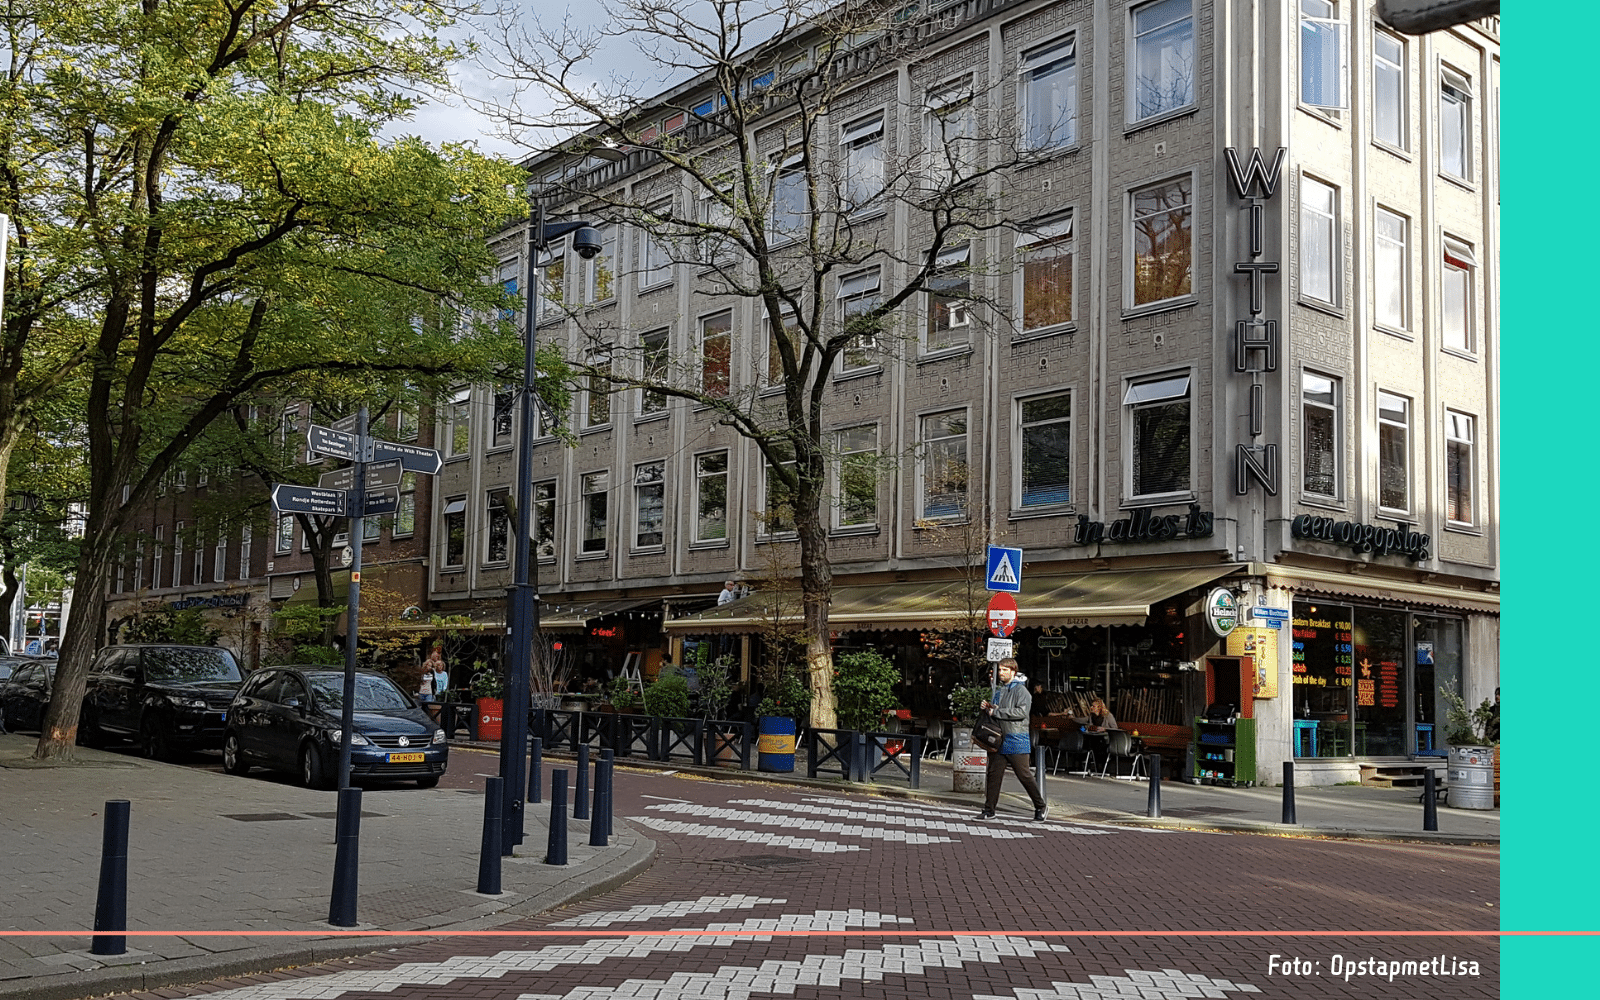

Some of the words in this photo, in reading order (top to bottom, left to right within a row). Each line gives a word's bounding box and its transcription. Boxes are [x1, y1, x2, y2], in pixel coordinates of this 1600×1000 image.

[1224, 147, 1287, 495] WITHIN
[311, 490, 336, 498] Westblaak
[1074, 514, 1104, 544] in
[1109, 508, 1179, 543] alles
[1184, 503, 1213, 538] is
[1291, 514, 1334, 540] een
[1334, 521, 1430, 561] oogopslag
[1309, 618, 1331, 628] Breakfast
[1303, 675, 1309, 684] of
[1309, 675, 1317, 685] the
[1318, 676, 1327, 687] day
